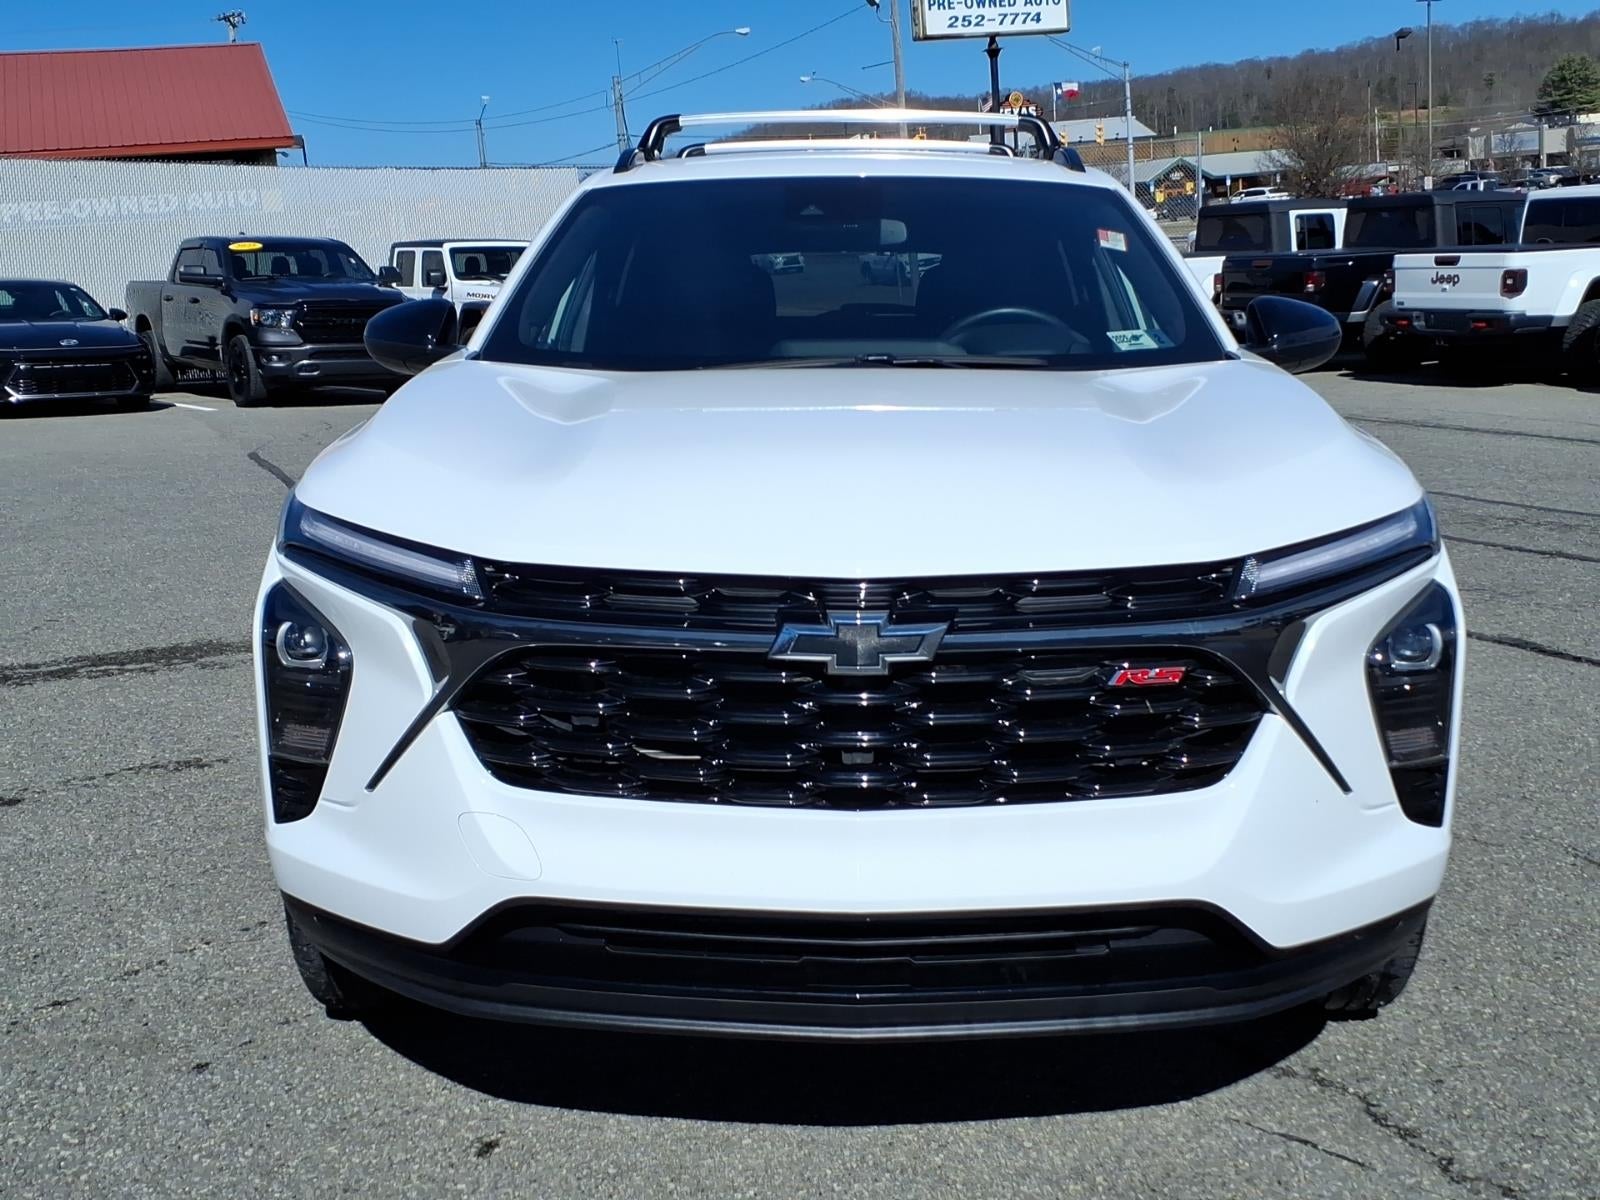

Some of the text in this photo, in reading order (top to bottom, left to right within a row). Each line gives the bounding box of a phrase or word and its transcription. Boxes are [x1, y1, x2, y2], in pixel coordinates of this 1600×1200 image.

[928, 0, 1017, 10] PRE-OWNED
[947, 12, 1042, 28] 252-7774
[1431, 271, 1460, 287] Jeep
[1107, 667, 1185, 686] RS
